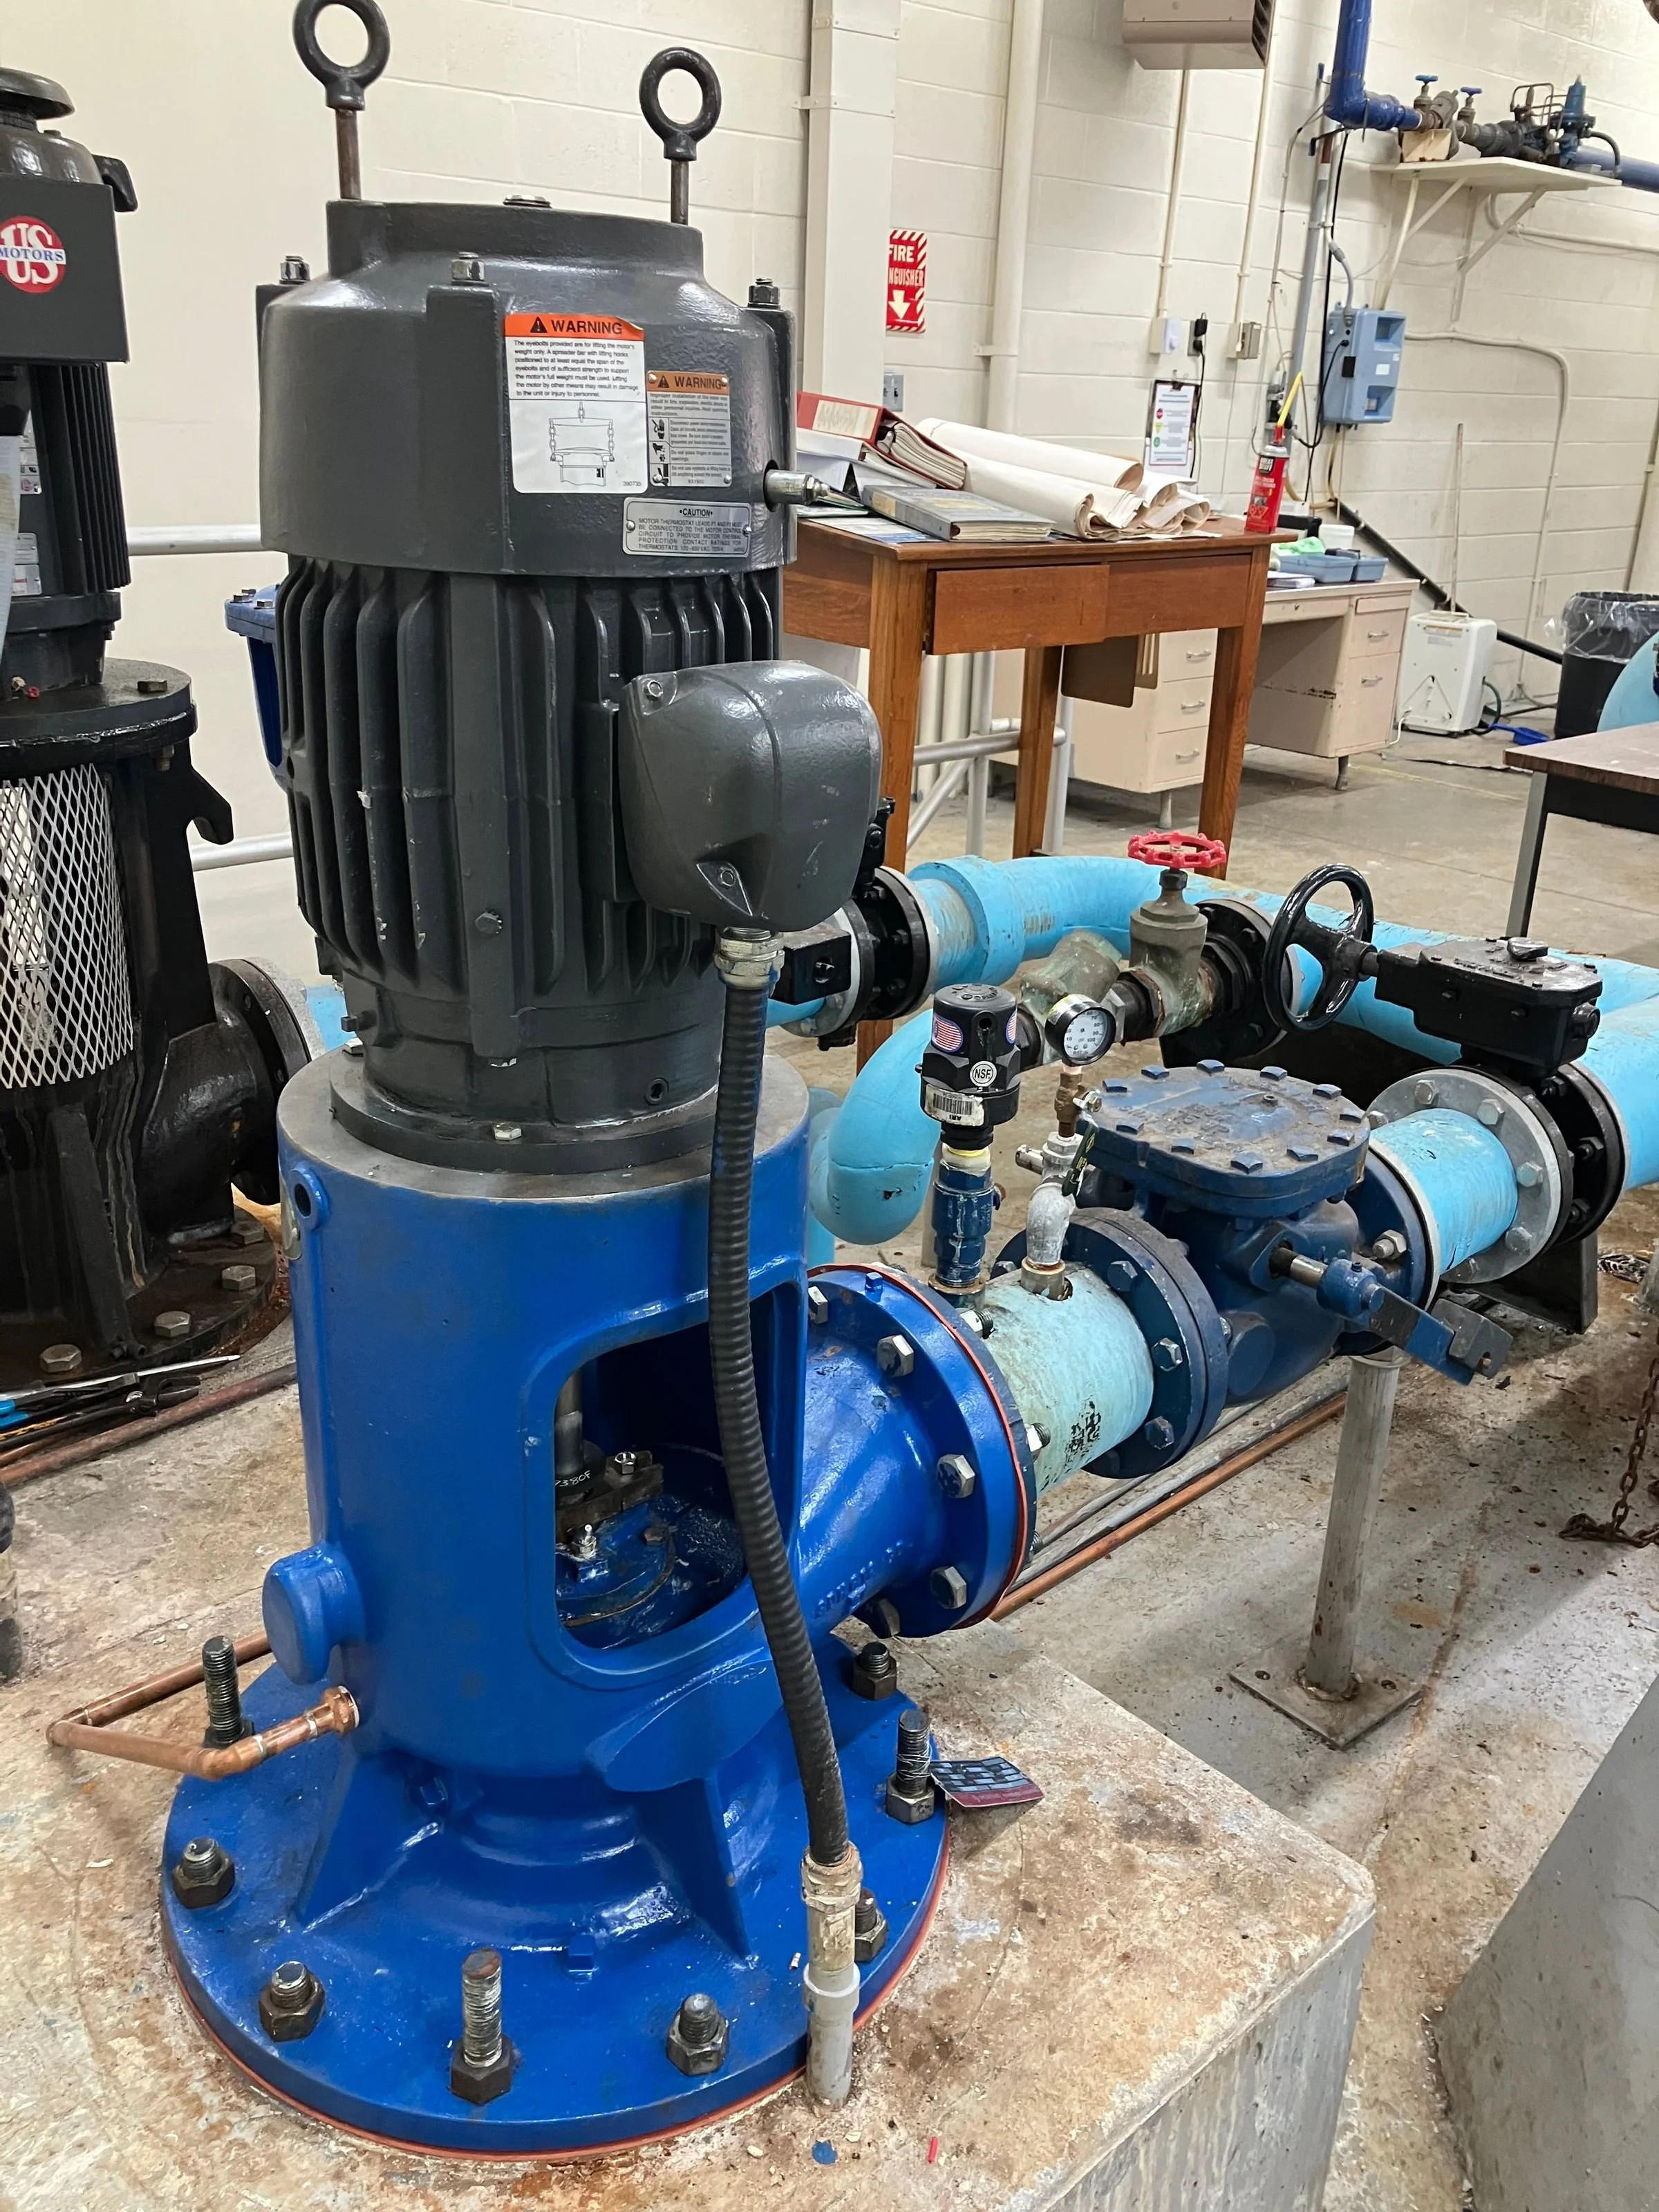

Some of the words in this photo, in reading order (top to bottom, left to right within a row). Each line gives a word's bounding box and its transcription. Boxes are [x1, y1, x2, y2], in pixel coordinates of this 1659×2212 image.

[551, 319, 622, 335] WARNING
[674, 375, 722, 390] WARNING
[683, 508, 710, 516] CAUTION
[975, 1069, 991, 1078] NSF
